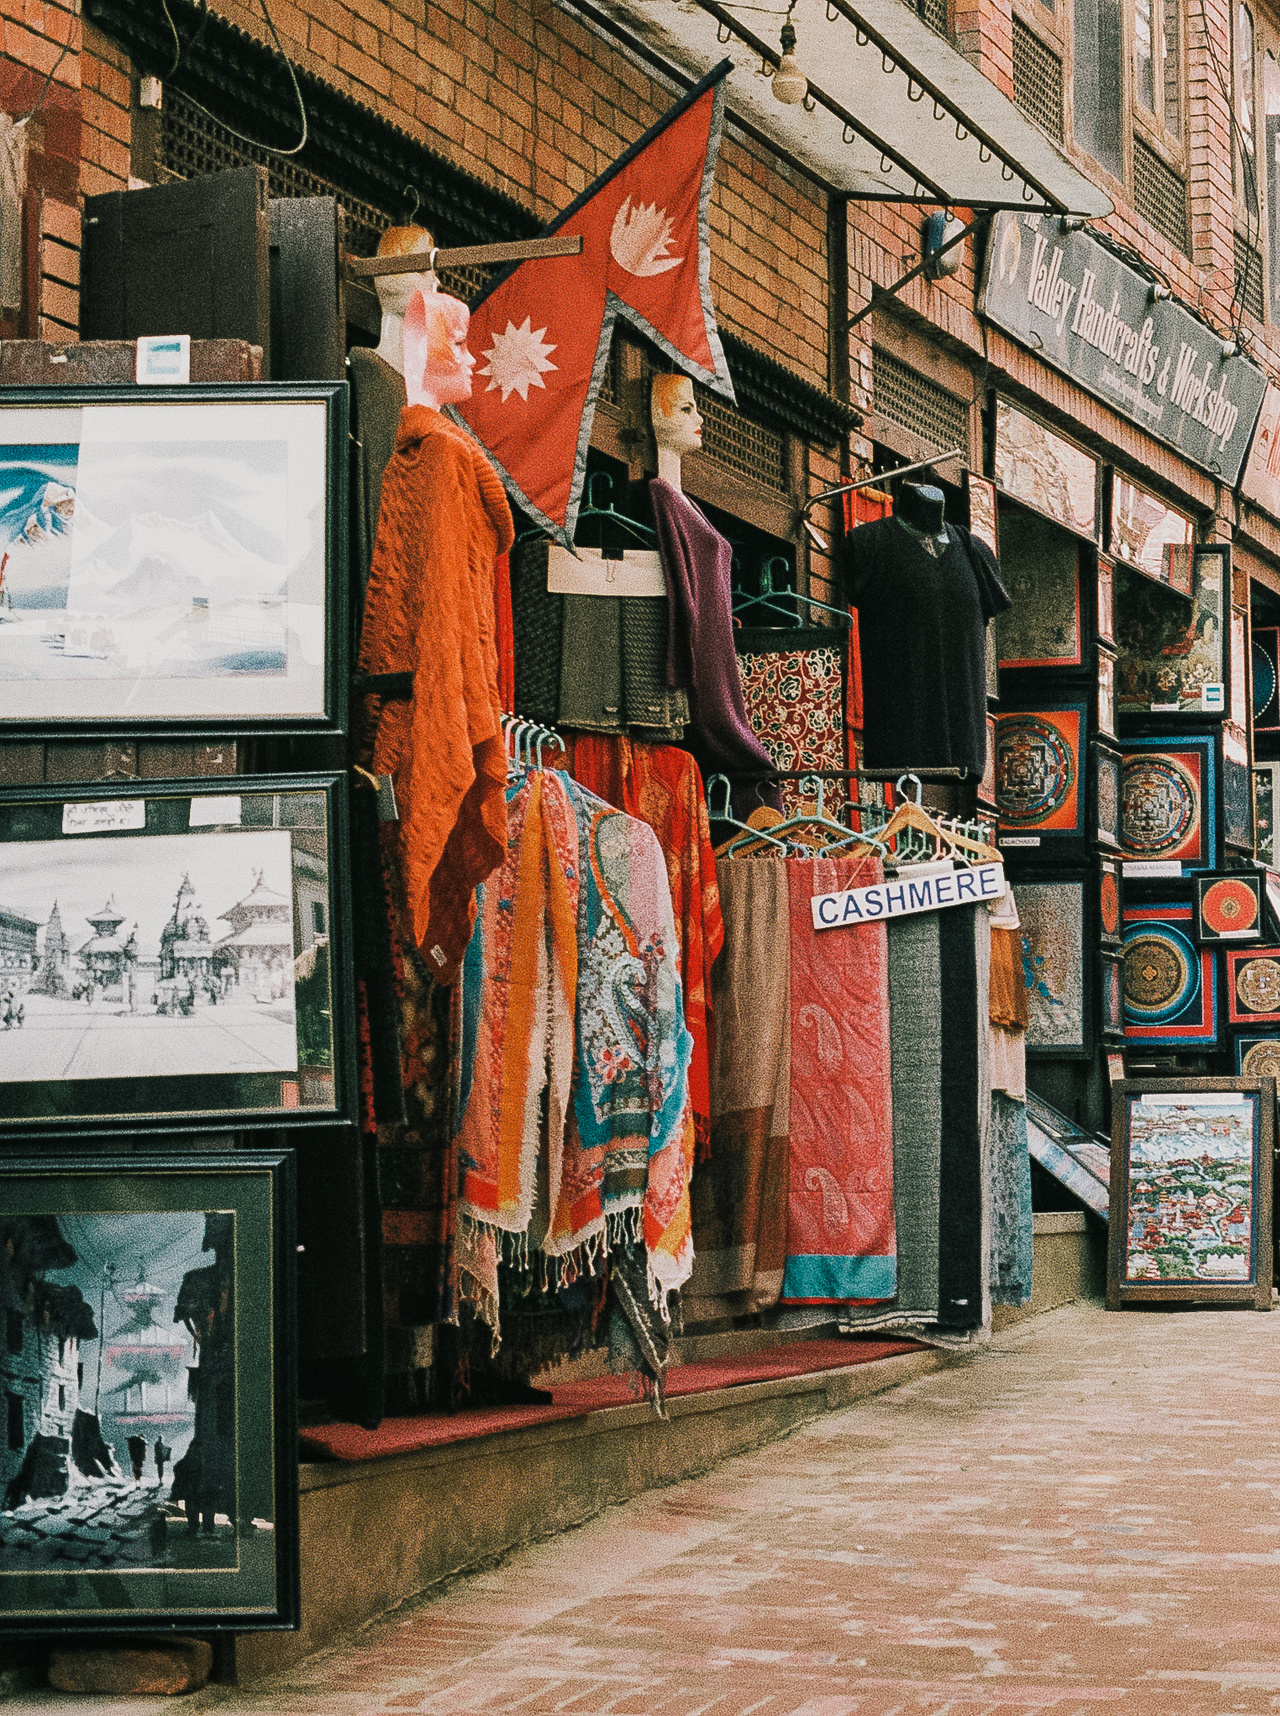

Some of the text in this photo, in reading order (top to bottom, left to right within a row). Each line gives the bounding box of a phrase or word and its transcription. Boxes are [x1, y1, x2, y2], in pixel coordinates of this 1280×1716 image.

[1028, 232, 1077, 336] Valley
[1071, 268, 1160, 385] Handicrafts
[1157, 357, 1171, 397] &
[1170, 342, 1239, 452] Workshop
[818, 868, 999, 925] CASHMERE
